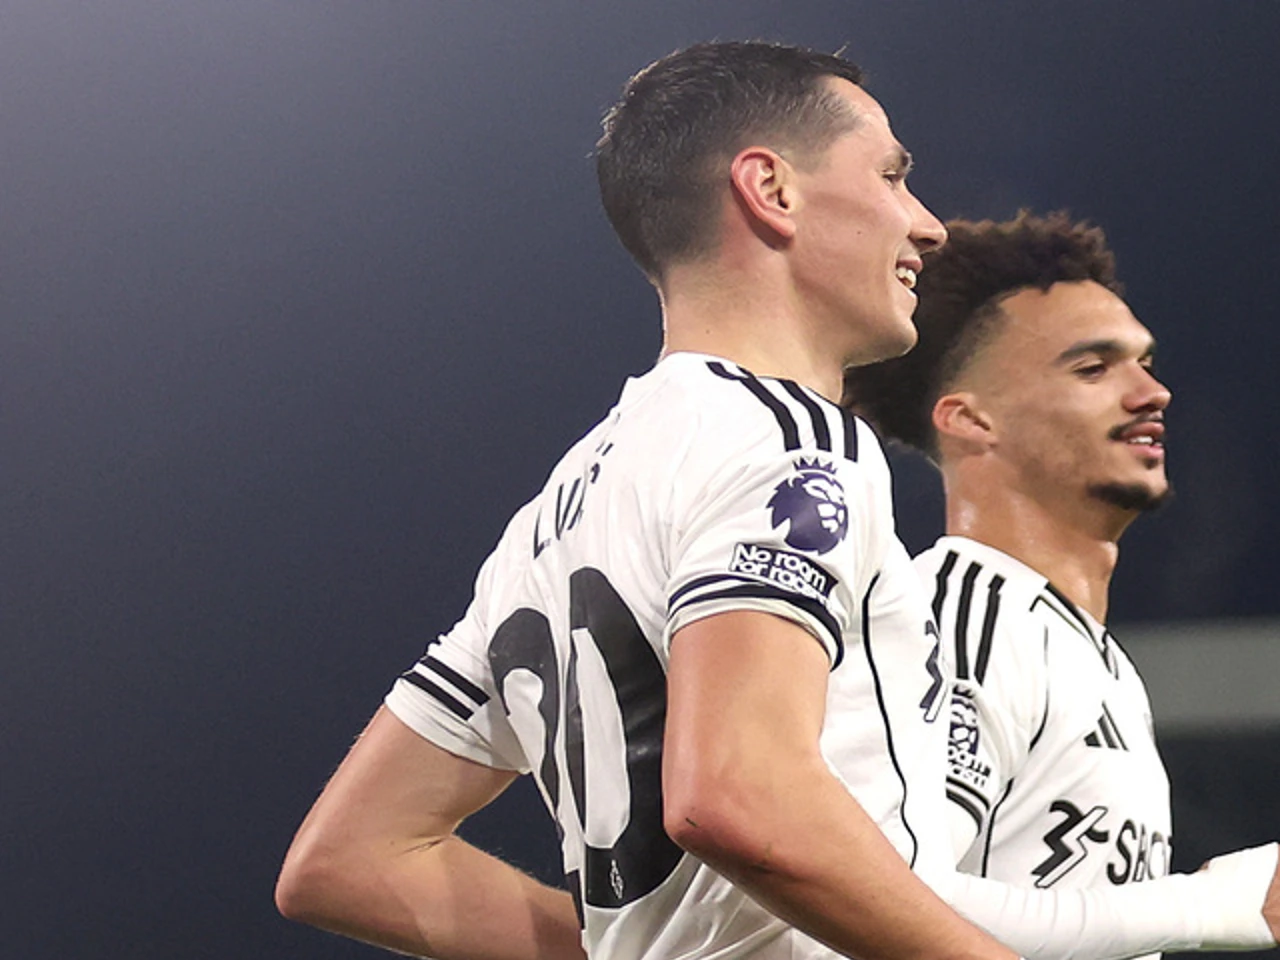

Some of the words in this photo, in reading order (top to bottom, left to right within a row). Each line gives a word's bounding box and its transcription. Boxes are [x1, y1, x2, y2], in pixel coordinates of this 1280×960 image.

[734, 543, 773, 563] No
[774, 552, 826, 592] room
[487, 566, 685, 931] 20
